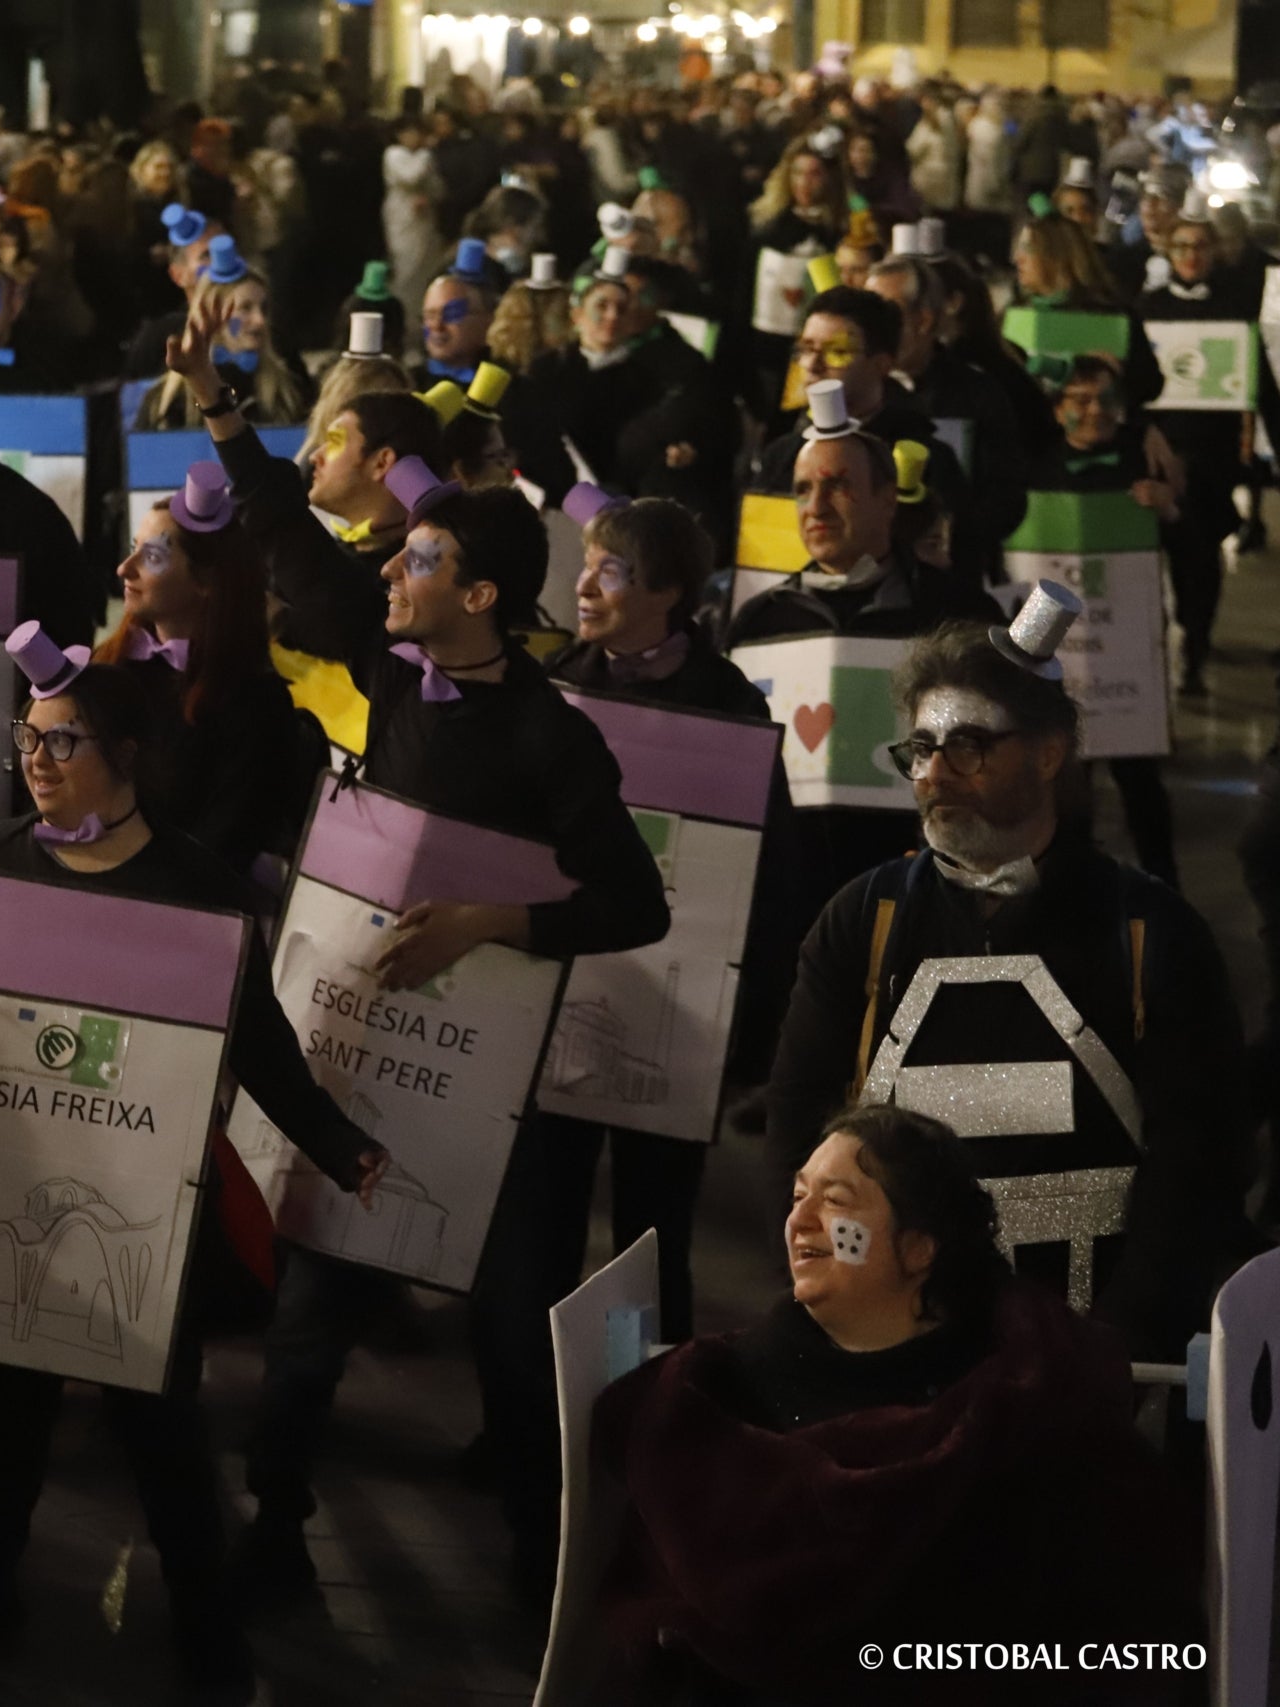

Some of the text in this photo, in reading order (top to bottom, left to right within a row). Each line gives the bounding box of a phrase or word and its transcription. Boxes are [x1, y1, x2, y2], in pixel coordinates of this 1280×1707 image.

[311, 977, 479, 1055] ESGLÉSIA DE
[305, 1029, 453, 1100] SANT PERE
[50, 1090, 156, 1134] FREIXA
